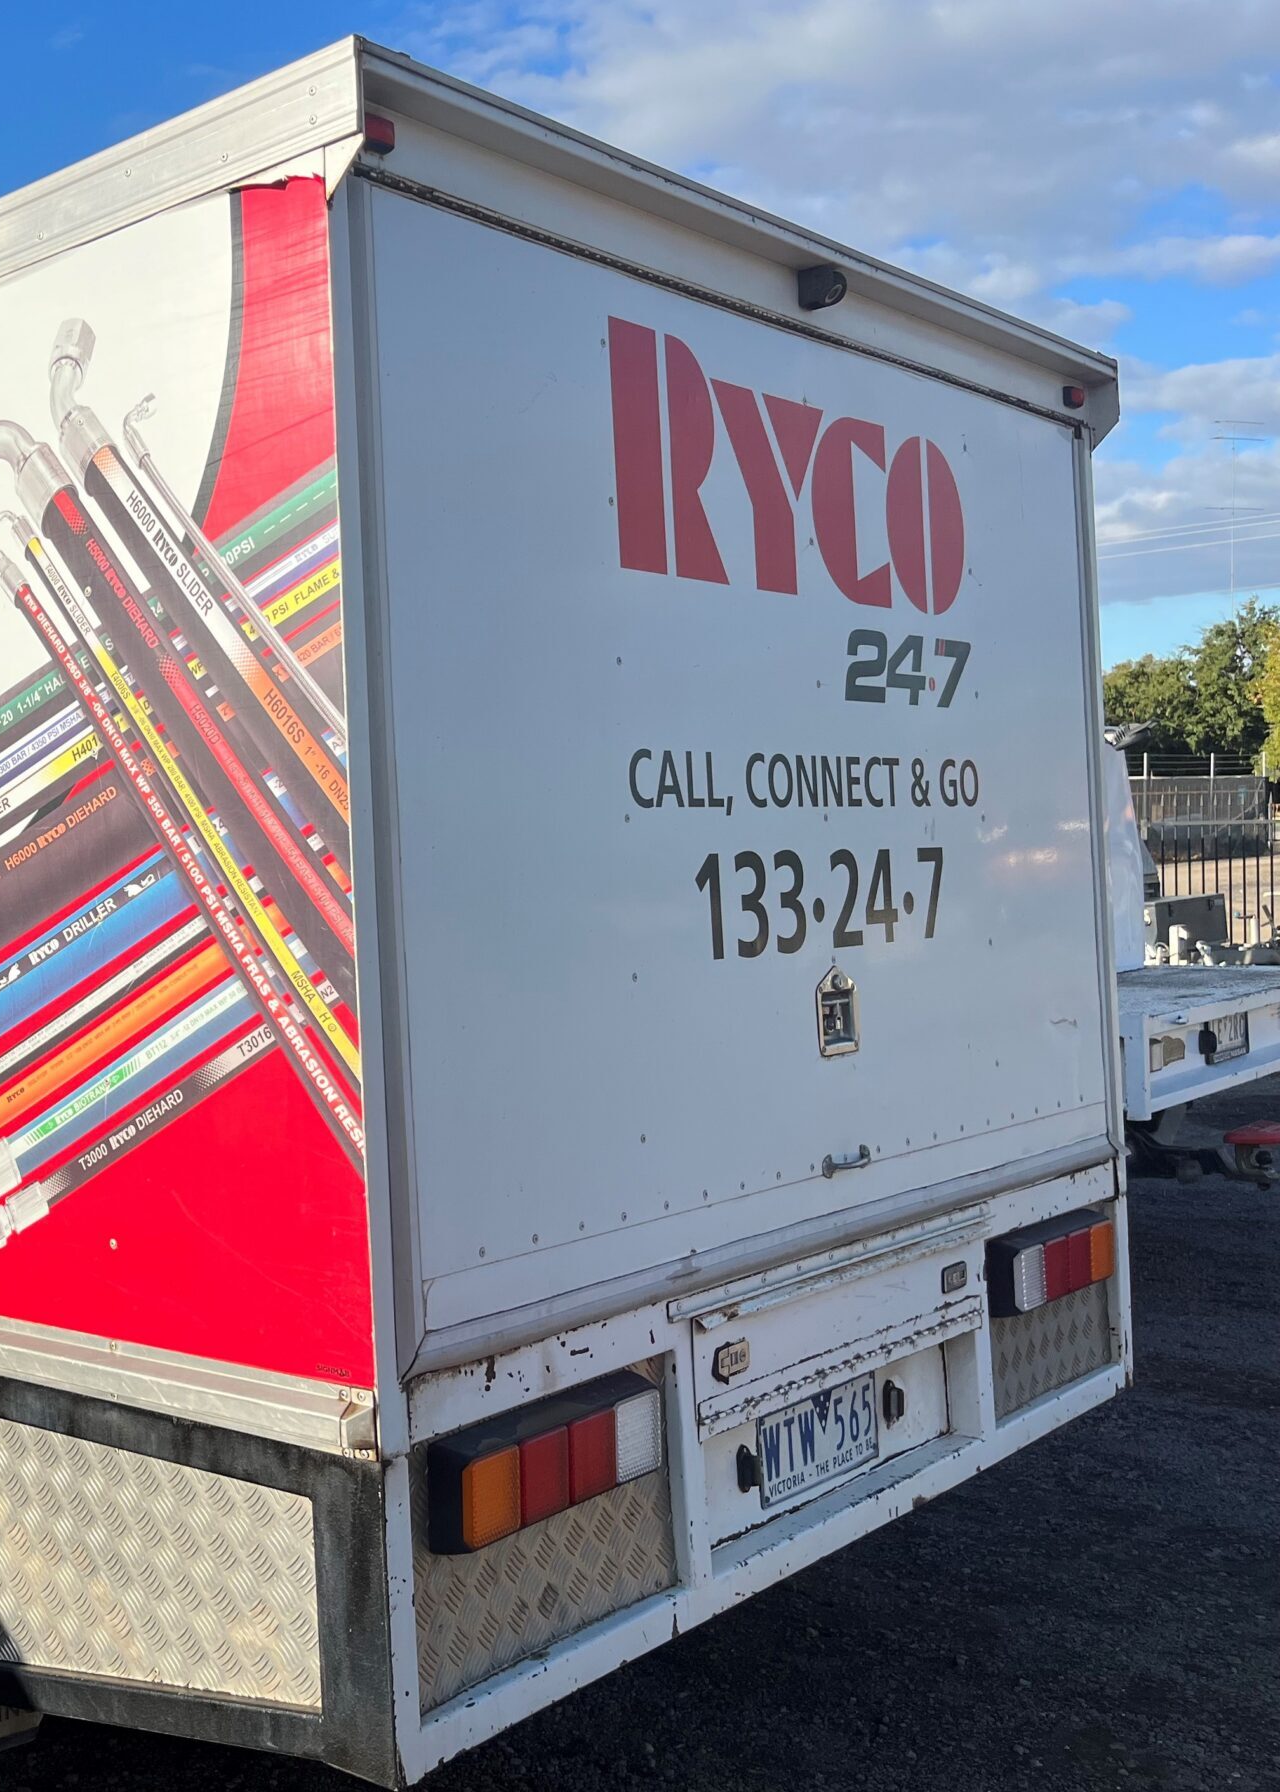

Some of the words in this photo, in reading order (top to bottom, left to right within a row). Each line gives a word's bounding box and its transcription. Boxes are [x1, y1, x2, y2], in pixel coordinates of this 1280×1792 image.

[608, 315, 965, 615] RYCO
[126, 491, 156, 532] H6000
[152, 527, 177, 567] RYCO
[176, 563, 214, 617] SLIDER
[70, 604, 91, 636] SLIDER
[85, 538, 110, 572] H5000
[122, 596, 160, 649] DIEHARD
[272, 602, 289, 621] PSI
[293, 574, 330, 605] FLAME
[11, 751, 28, 769] BAR
[59, 712, 82, 735] MSHA
[263, 688, 305, 744] H6016S
[629, 748, 734, 816] CALL,
[746, 752, 900, 808] CONNECT
[911, 763, 932, 808] &
[940, 759, 980, 807] GO
[4, 842, 38, 871] H6000
[36, 824, 67, 849] RYCO
[66, 786, 117, 830] DIEHARD
[36, 612, 66, 654] DIEHARD
[119, 748, 137, 776] MAX
[135, 775, 150, 794] WP
[147, 794, 165, 819] 350
[161, 819, 181, 847] BAR
[181, 852, 204, 885] 5100
[201, 885, 220, 911] PSI
[215, 910, 245, 956] MSHA
[241, 954, 271, 996] FRAS
[277, 1015, 338, 1104] ABRASION
[110, 672, 132, 701] T4006S
[213, 842, 237, 880] ABRASION
[291, 970, 316, 1003] MSHA
[28, 938, 60, 965] RYCO
[63, 898, 117, 942] DRILLER
[73, 1081, 109, 1114] BIOTRAN
[77, 1144, 109, 1170] T3000
[108, 1123, 137, 1150] RYCO
[135, 1089, 184, 1130] DIEHARD
[236, 1026, 272, 1057] T3016
[762, 1408, 815, 1482] WTW
[834, 1383, 871, 1450] 565
[768, 1472, 806, 1498] VICTORIA
[815, 1461, 830, 1477] THE
[832, 1451, 854, 1472] PLACE
[855, 1444, 864, 1457] TO
